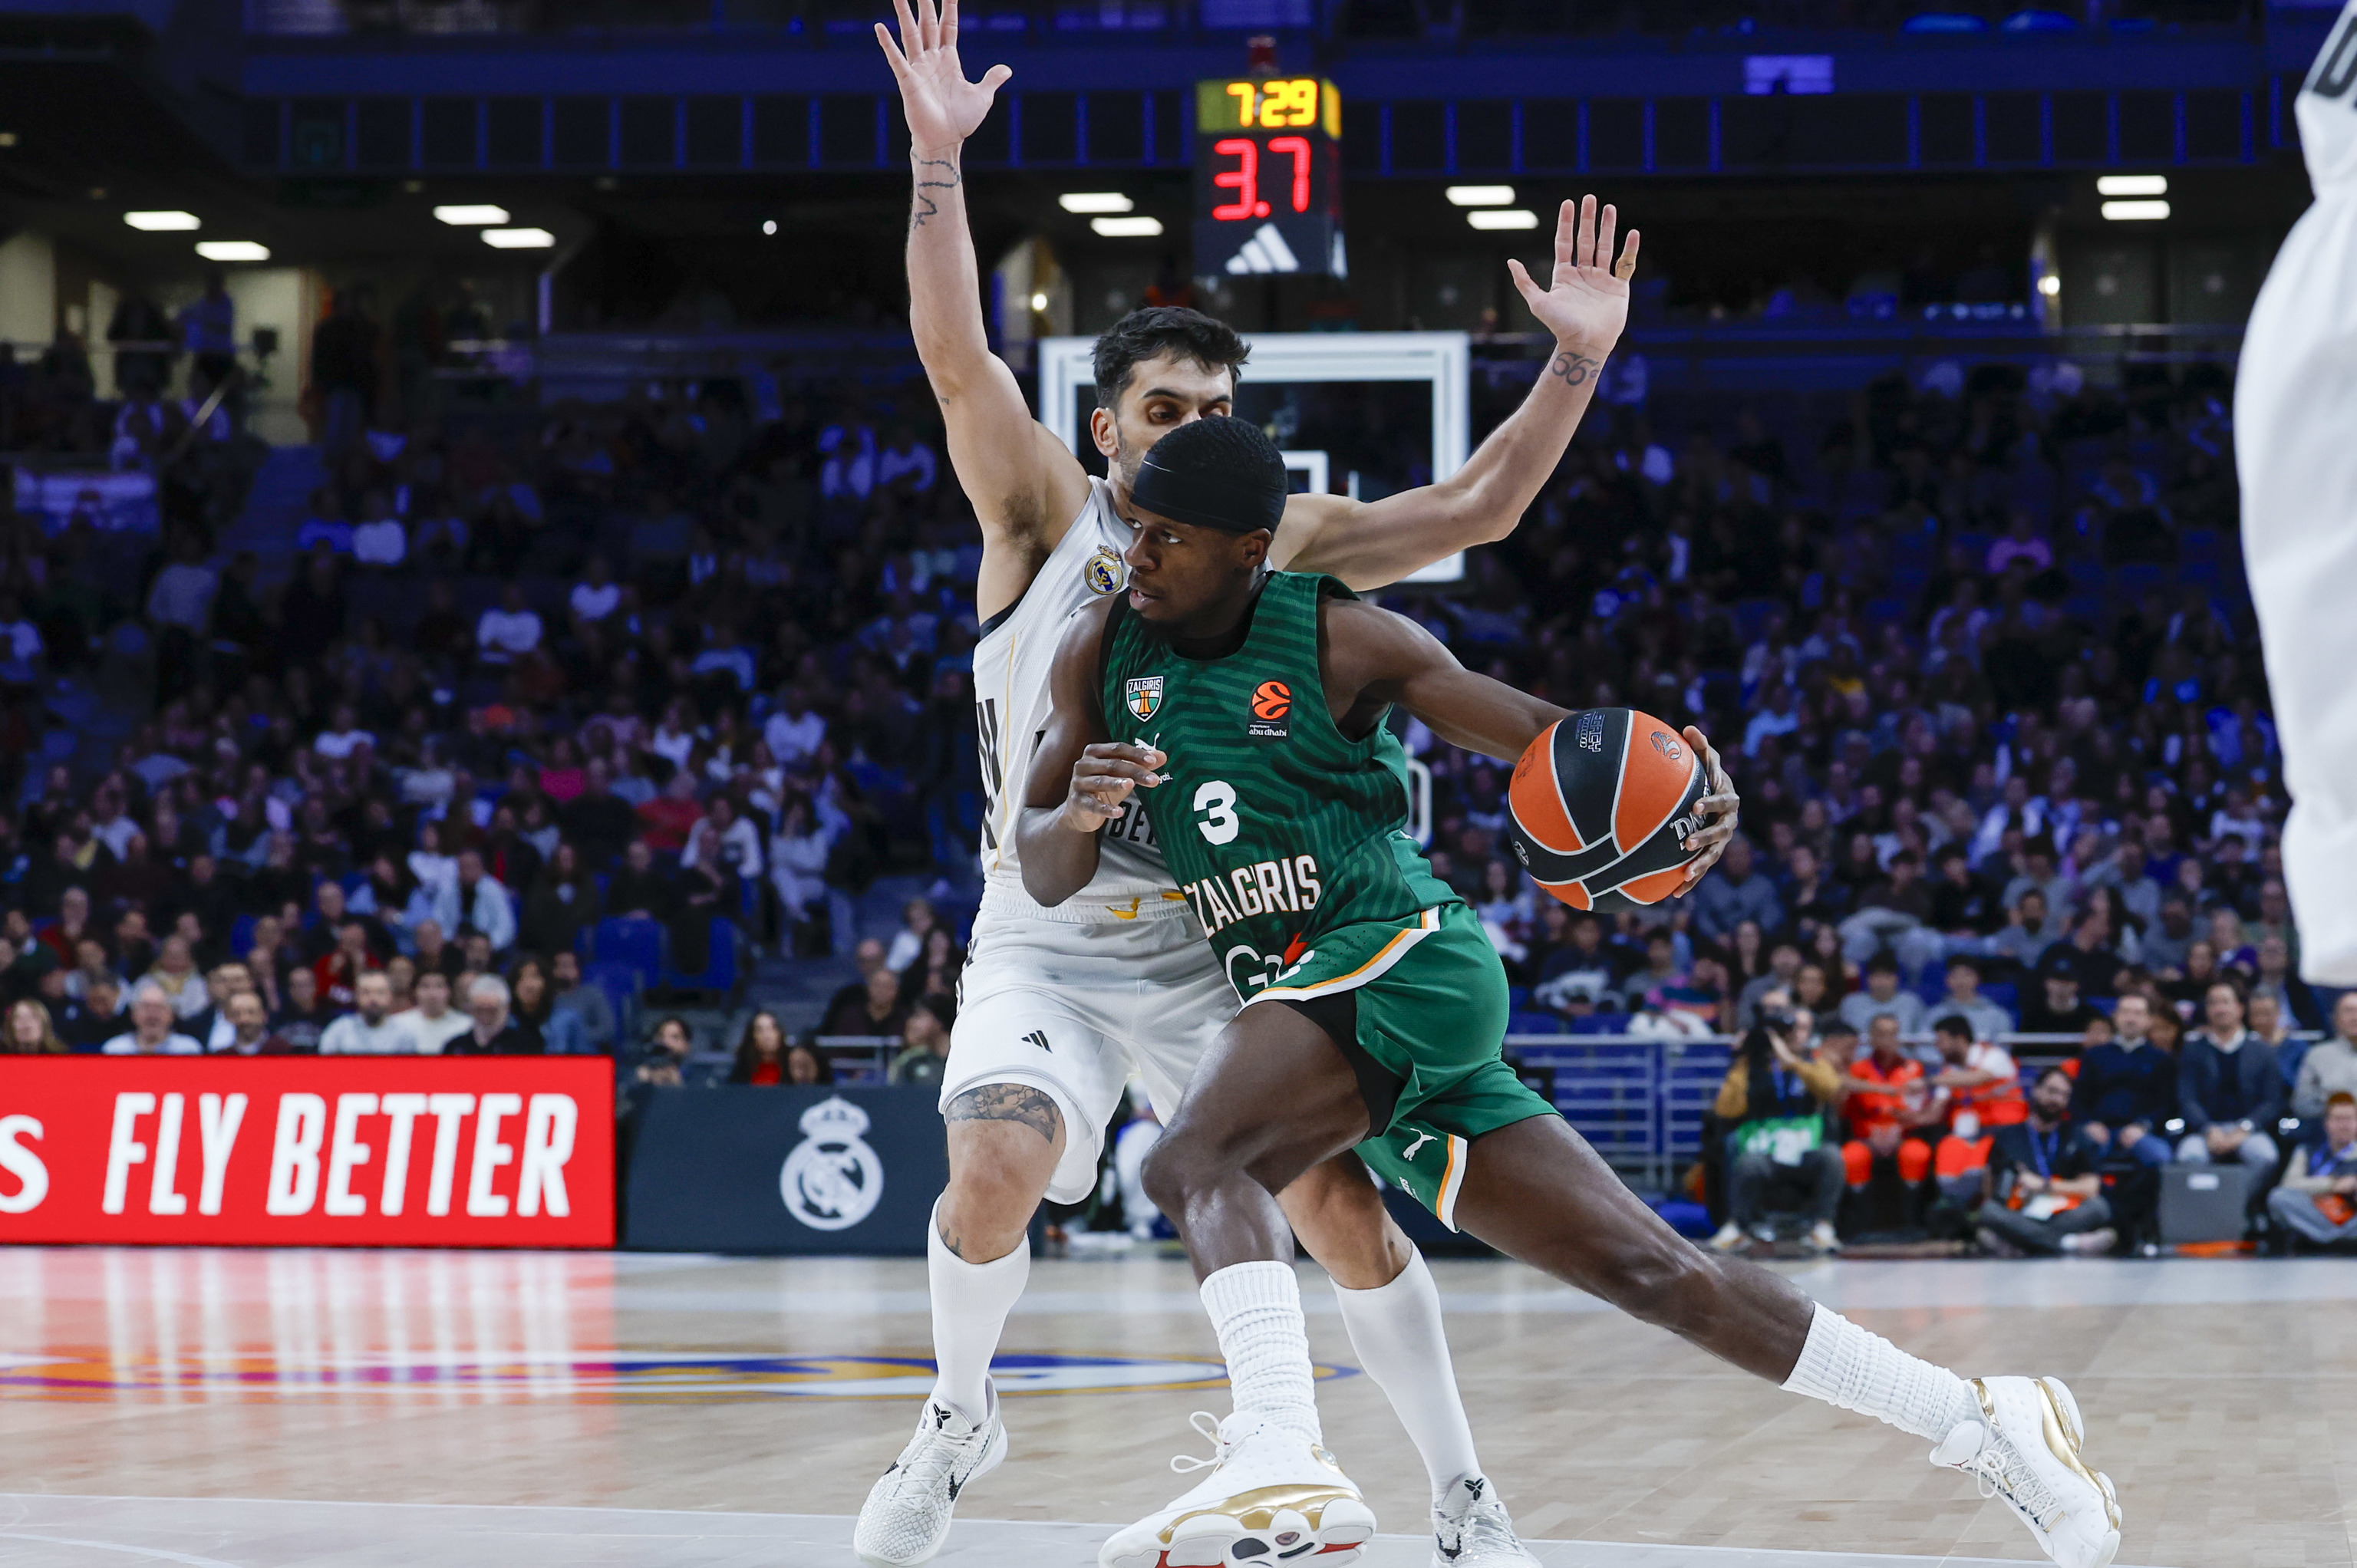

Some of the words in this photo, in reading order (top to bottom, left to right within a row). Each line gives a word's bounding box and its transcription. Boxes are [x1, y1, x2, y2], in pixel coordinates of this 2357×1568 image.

[1212, 137, 1311, 221] 3.7
[1129, 679, 1161, 693] ZALGIRIS
[1193, 780, 1240, 845] 3
[1182, 855, 1322, 939] ZALGRIS
[102, 1092, 249, 1215] FLY
[265, 1092, 579, 1217] BETTER
